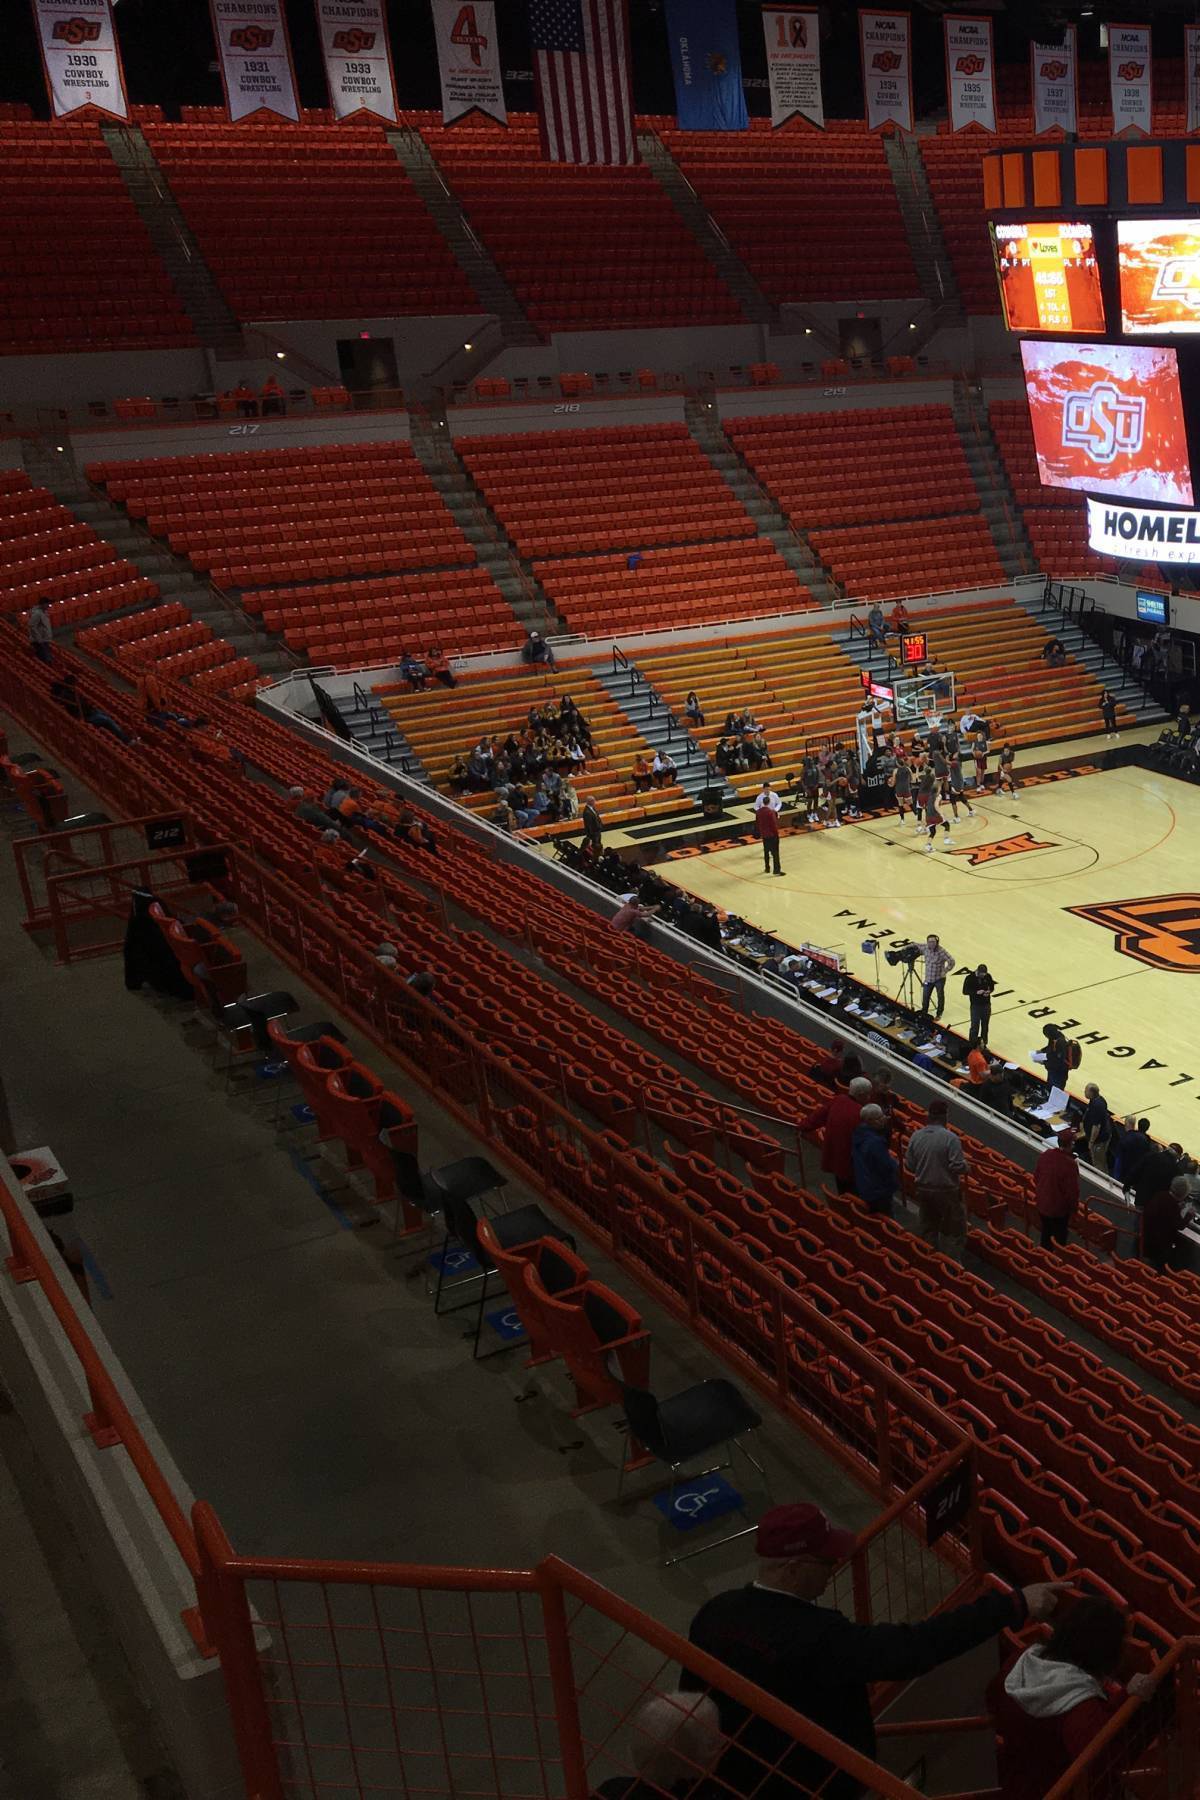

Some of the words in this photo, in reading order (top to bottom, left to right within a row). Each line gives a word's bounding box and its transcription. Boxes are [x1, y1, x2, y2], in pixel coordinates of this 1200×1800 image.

[216, 3, 277, 15] CHAMPIONS
[322, 6, 379, 18] CHAMPIONS
[875, 20, 896, 31] NCAA
[451, 5, 488, 67] 4
[865, 31, 906, 42] CHAMPIONS
[949, 36, 989, 46] CHAMPIONS
[67, 55, 97, 67] 1930
[679, 35, 693, 86] OKLAHOMA
[244, 61, 270, 72] 1931
[345, 63, 372, 74] 1933
[65, 69, 104, 79] COWBOY
[240, 75, 277, 84] COWBOY
[63, 79, 110, 88] WRESTLING
[342, 76, 377, 86] COWBOY
[239, 84, 281, 93] WRESTLING
[341, 85, 382, 95] WRESTLING
[963, 83, 982, 94] 1935
[960, 95, 985, 103] COWBOY
[1001, 258, 1010, 267] PL
[1021, 258, 1031, 267] PT
[1063, 258, 1072, 267] PL
[1085, 258, 1095, 267] PT
[824, 386, 847, 398] 219
[552, 403, 581, 414] 218
[1061, 381, 1146, 464] OSU
[228, 423, 260, 435] 217
[907, 645, 922, 660] 30
[153, 827, 180, 841] 212
[936, 1482, 961, 1520] 211
